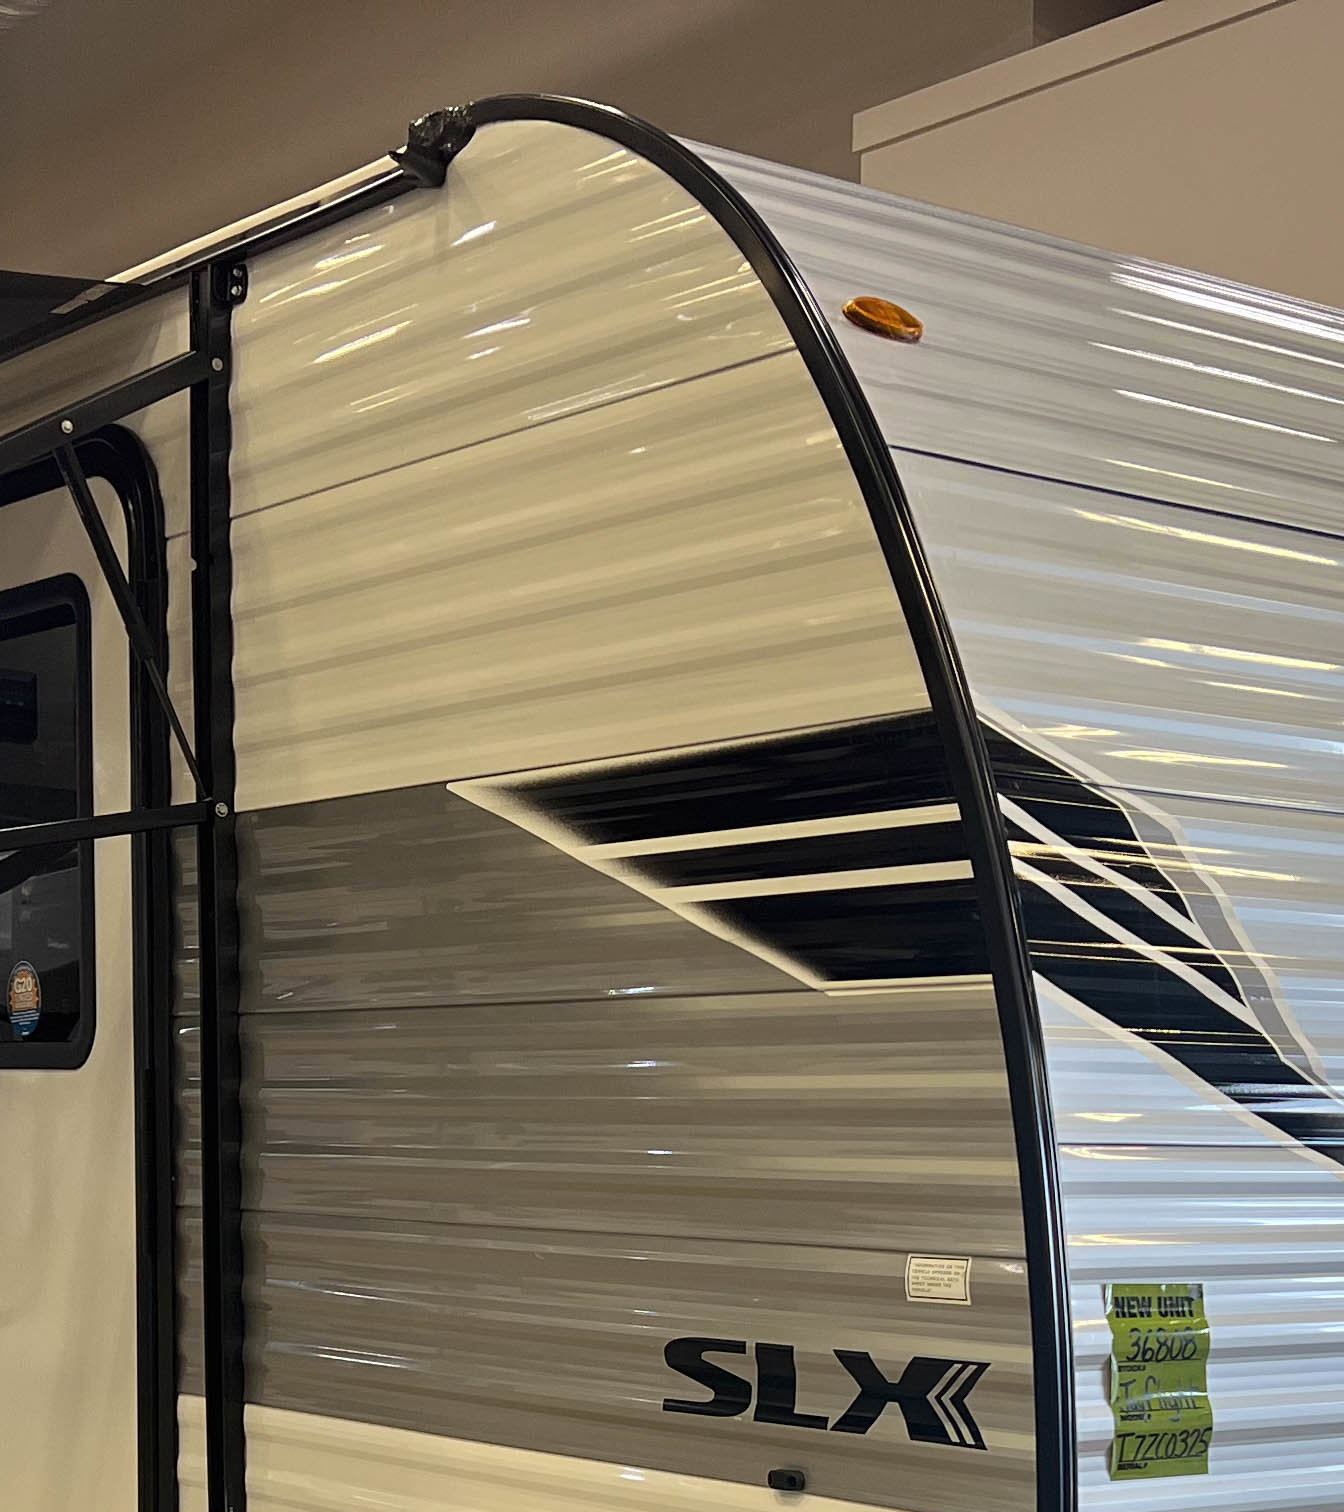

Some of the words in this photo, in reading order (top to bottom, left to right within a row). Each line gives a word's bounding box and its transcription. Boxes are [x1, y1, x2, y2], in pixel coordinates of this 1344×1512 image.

[1114, 1296, 1152, 1319] NEW
[1157, 1296, 1194, 1318] UNIT
[662, 1336, 992, 1451] SLX
